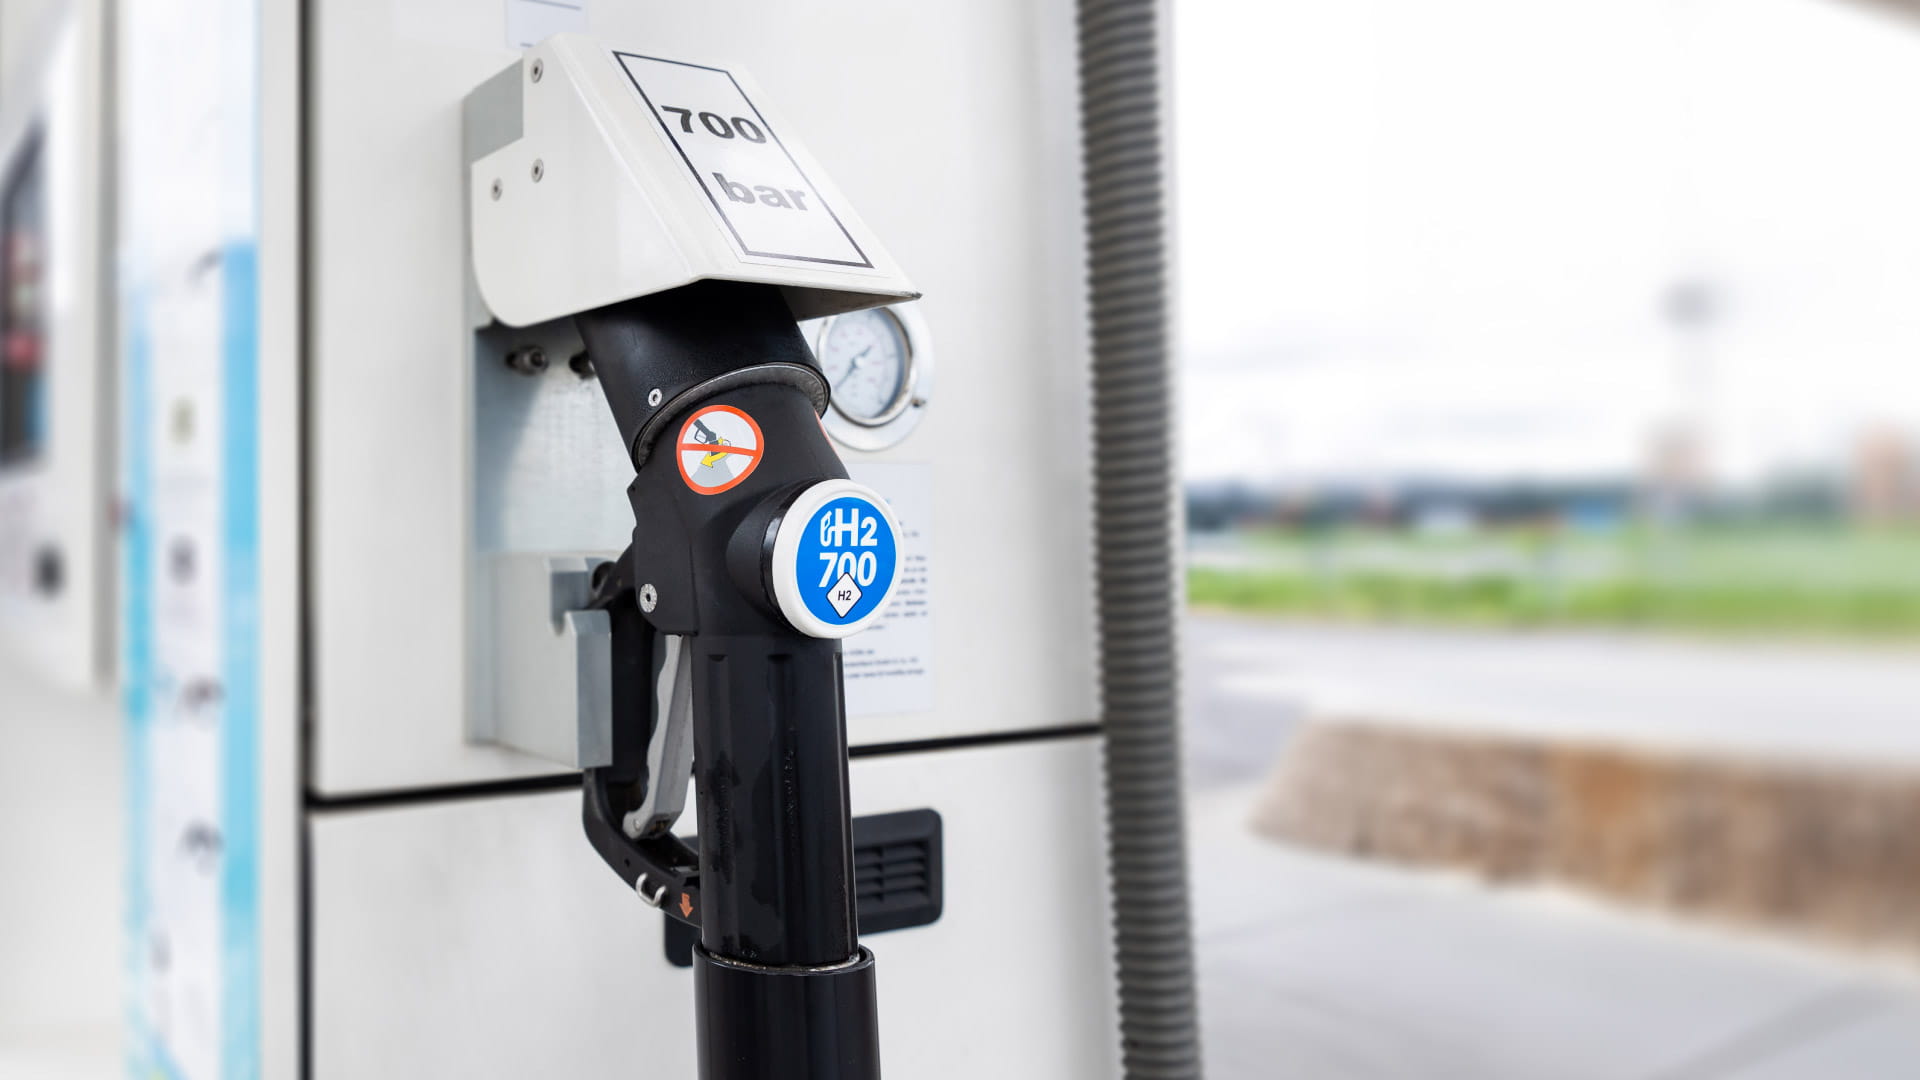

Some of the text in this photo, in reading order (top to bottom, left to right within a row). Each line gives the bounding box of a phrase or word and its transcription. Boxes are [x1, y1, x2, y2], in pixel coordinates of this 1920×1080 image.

[661, 105, 767, 144] 700
[712, 171, 809, 211] bar
[834, 508, 878, 547] H2
[818, 551, 877, 588] 700
[837, 590, 852, 601] H2
